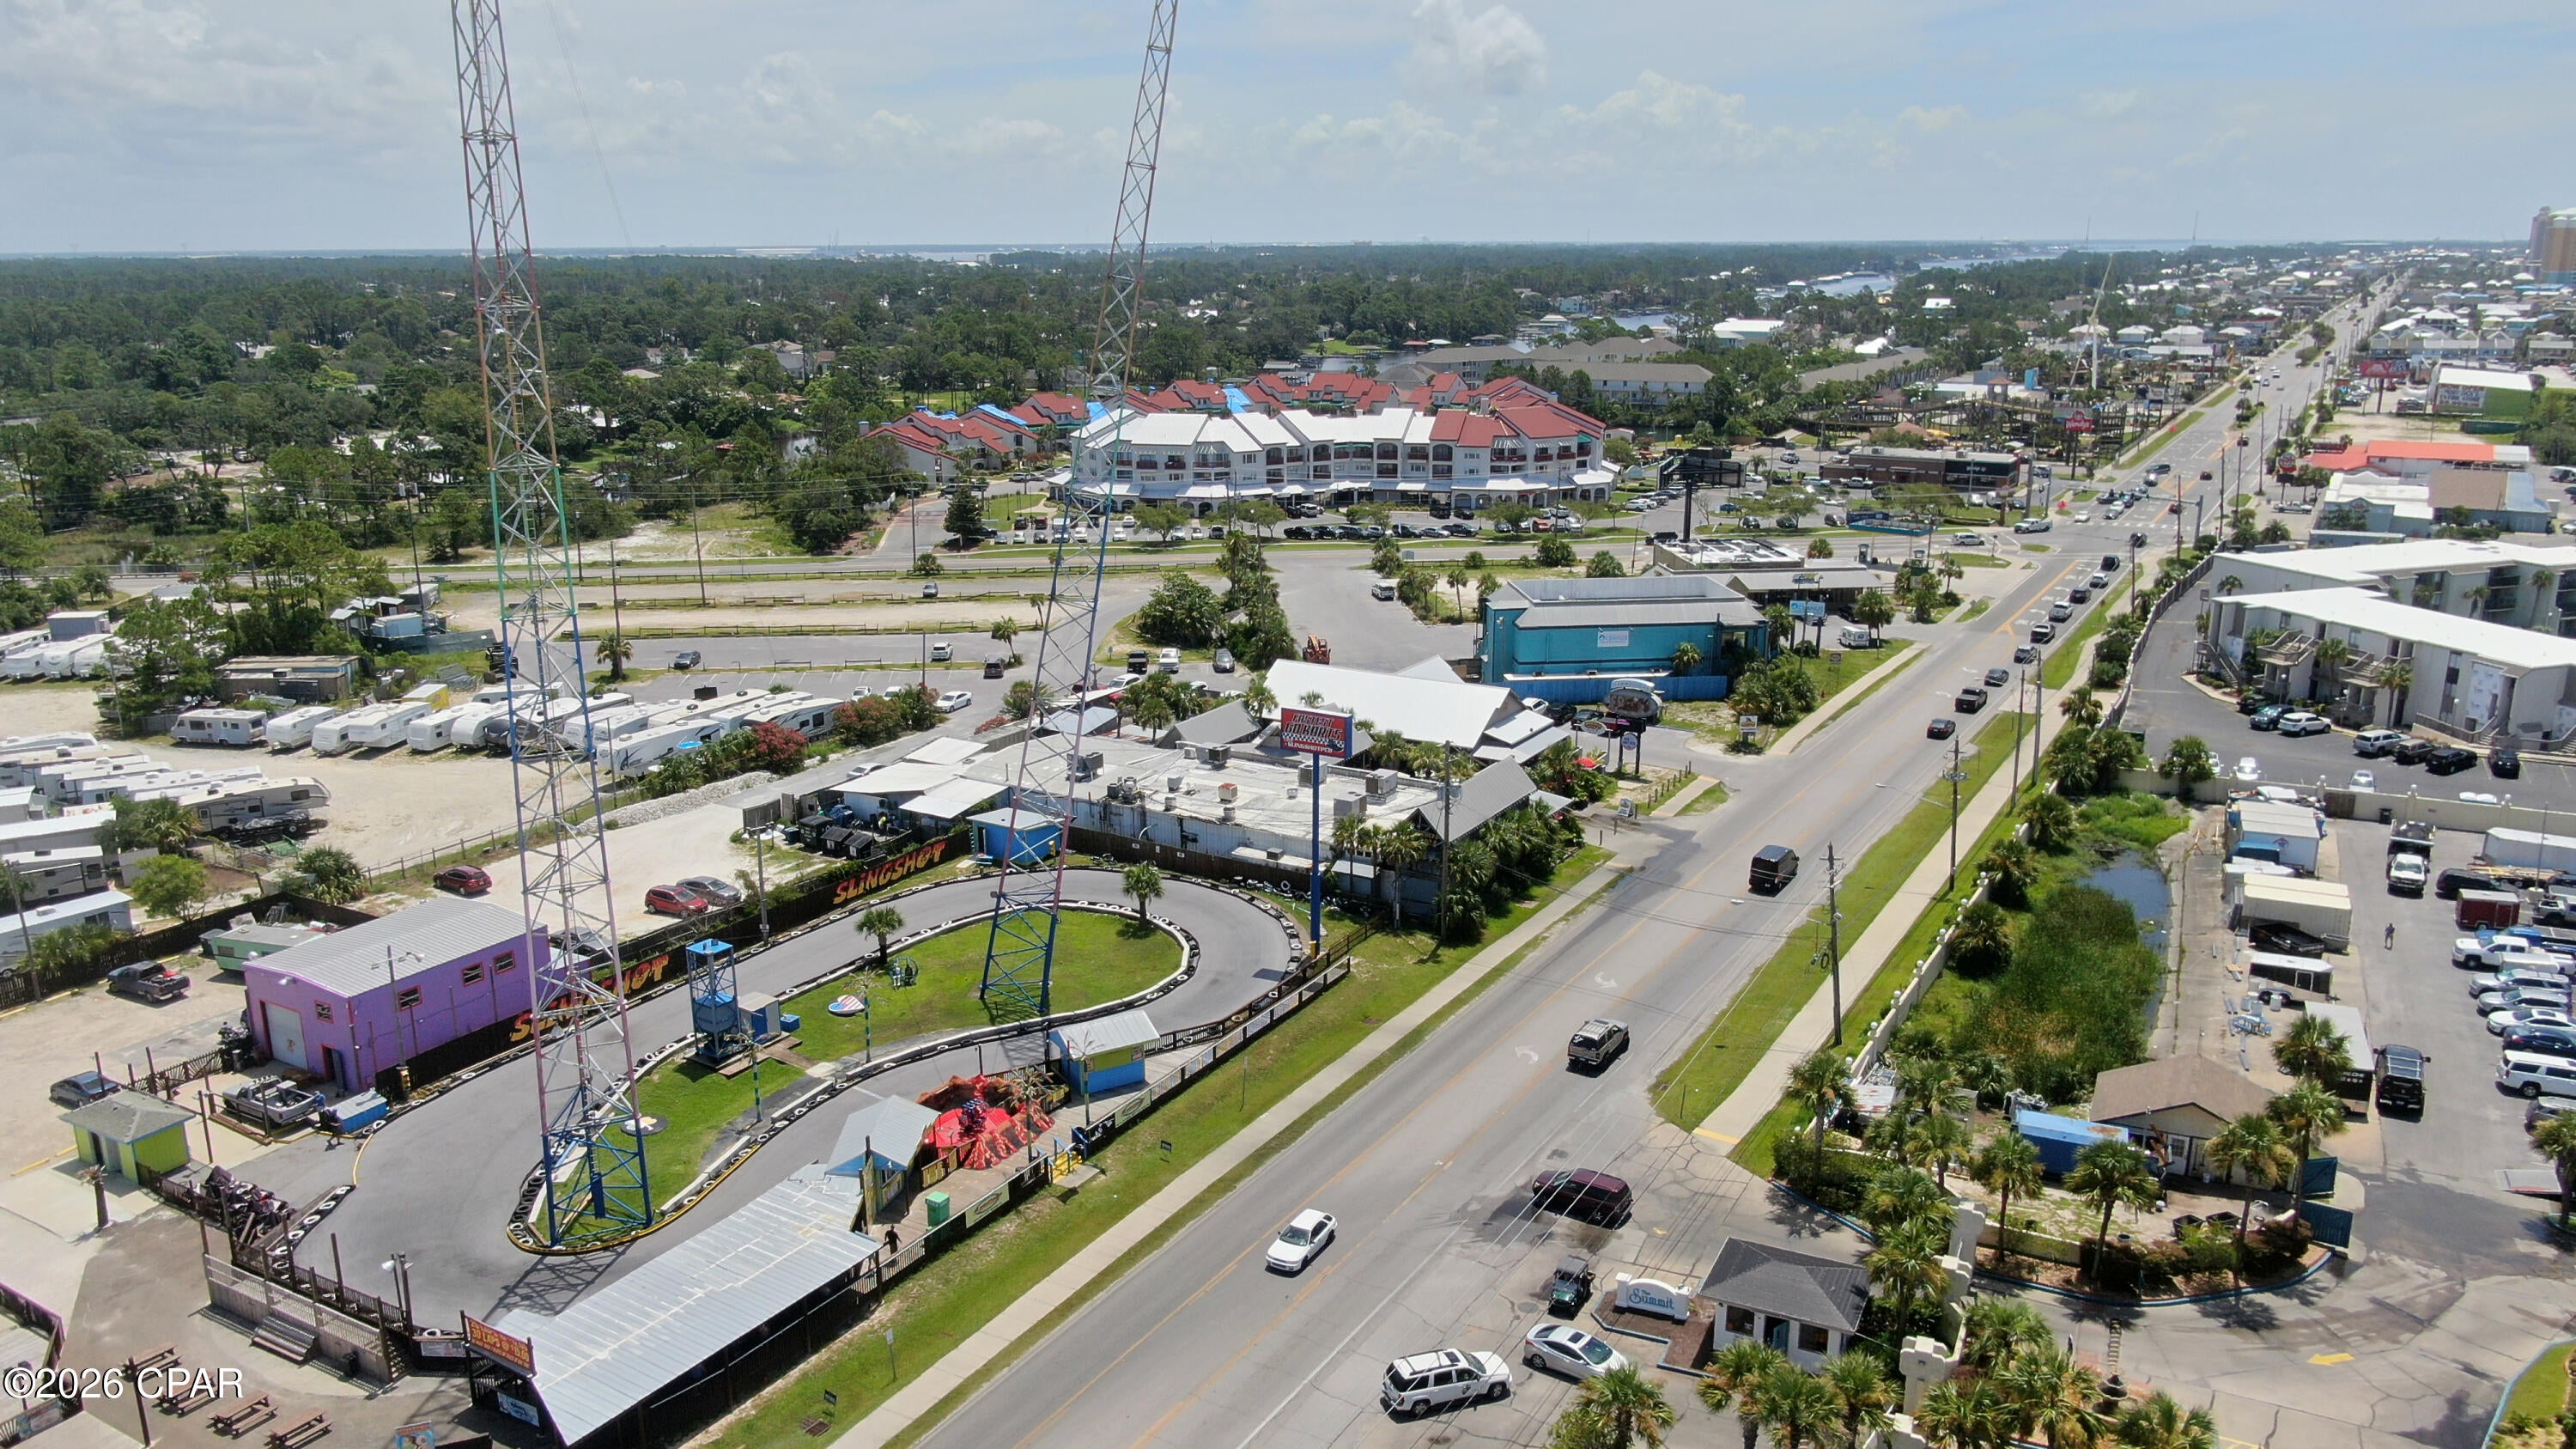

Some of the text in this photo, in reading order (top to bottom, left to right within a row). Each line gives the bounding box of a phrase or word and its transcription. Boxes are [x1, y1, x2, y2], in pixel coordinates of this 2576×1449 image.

[1292, 713, 1334, 728] FASTEST
[1284, 721, 1343, 740] GO KARTS
[832, 839, 948, 904] SLINGSHOT
[1629, 1288, 1674, 1309] Summit
[483, 1331, 501, 1349] LAPS
